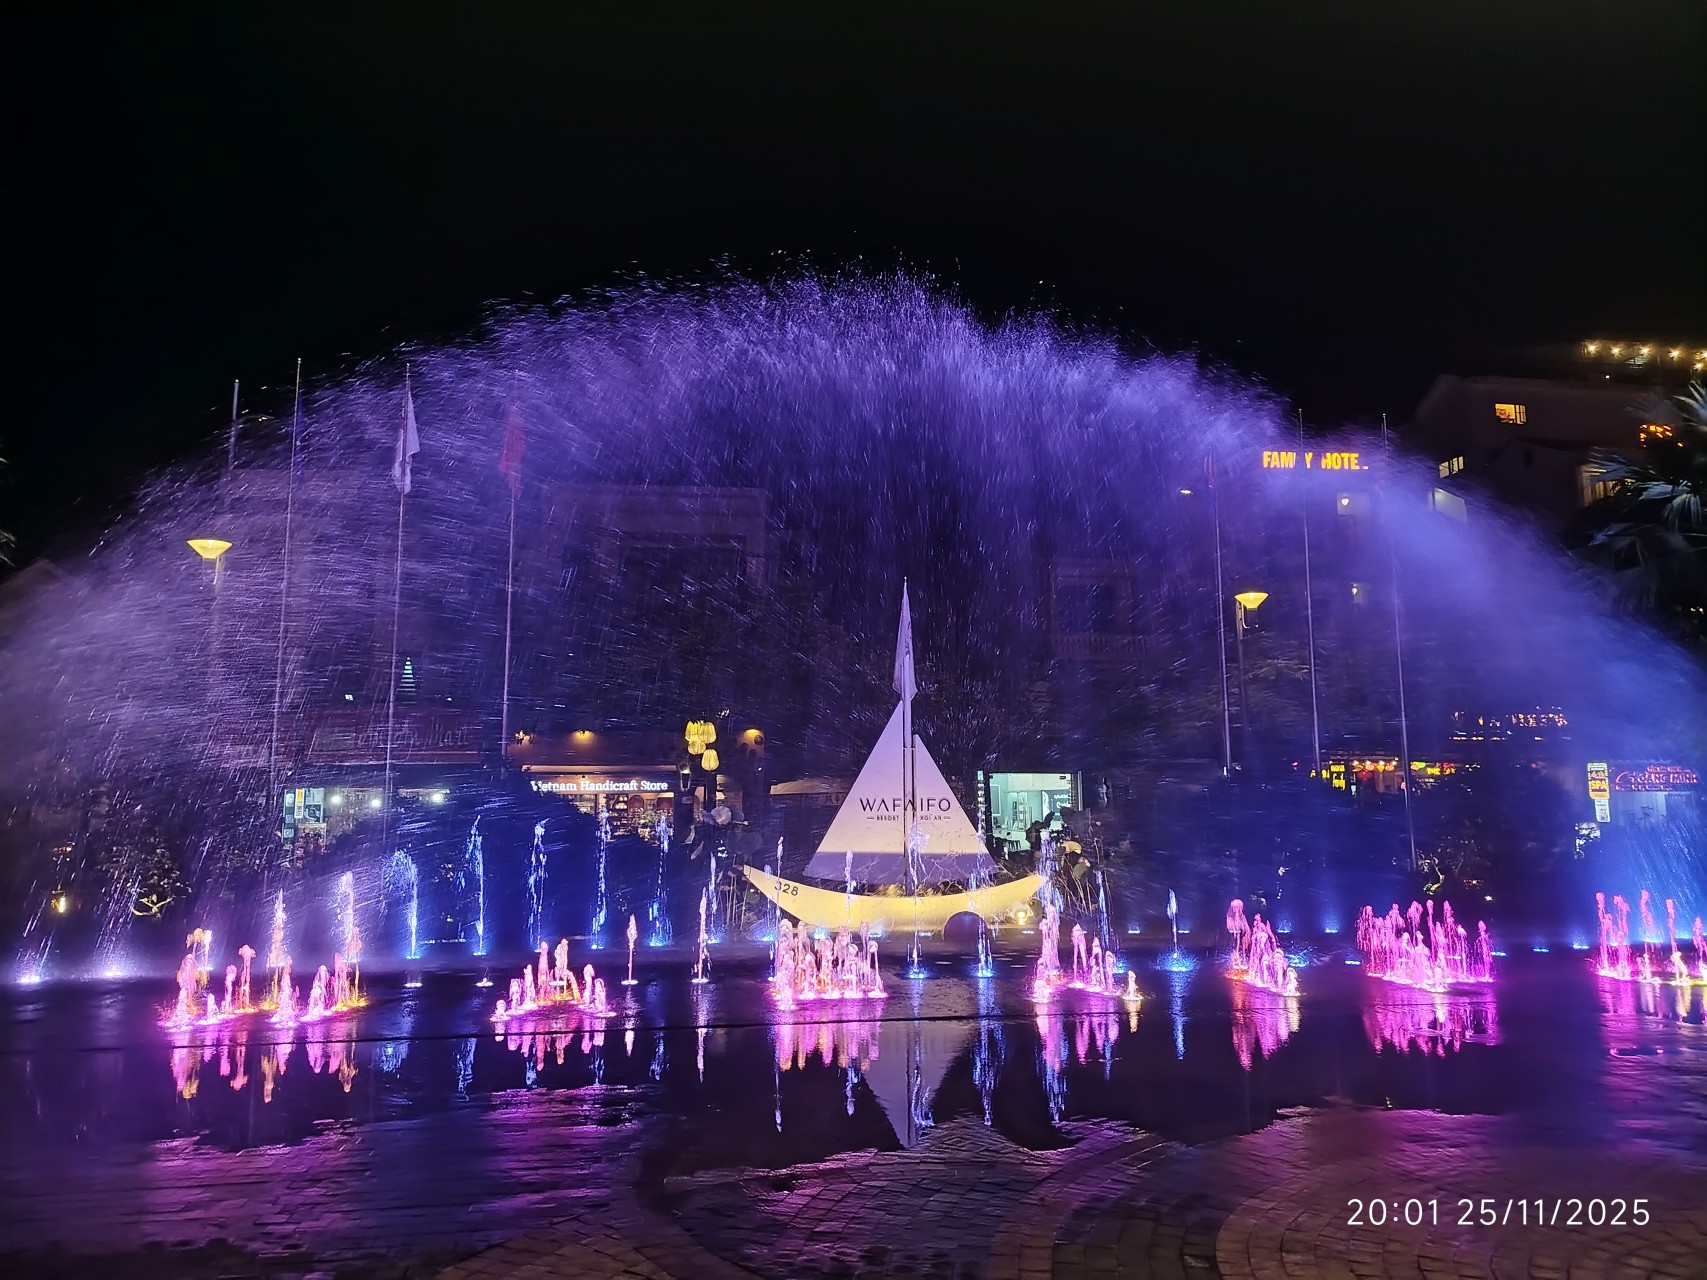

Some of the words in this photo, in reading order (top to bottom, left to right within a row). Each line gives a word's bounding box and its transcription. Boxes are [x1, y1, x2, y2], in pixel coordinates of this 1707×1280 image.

[1321, 452, 1369, 470] HOTE
[580, 779, 639, 791] Handicraft
[640, 780, 668, 791] Store
[859, 798, 951, 812] WAFAIFO
